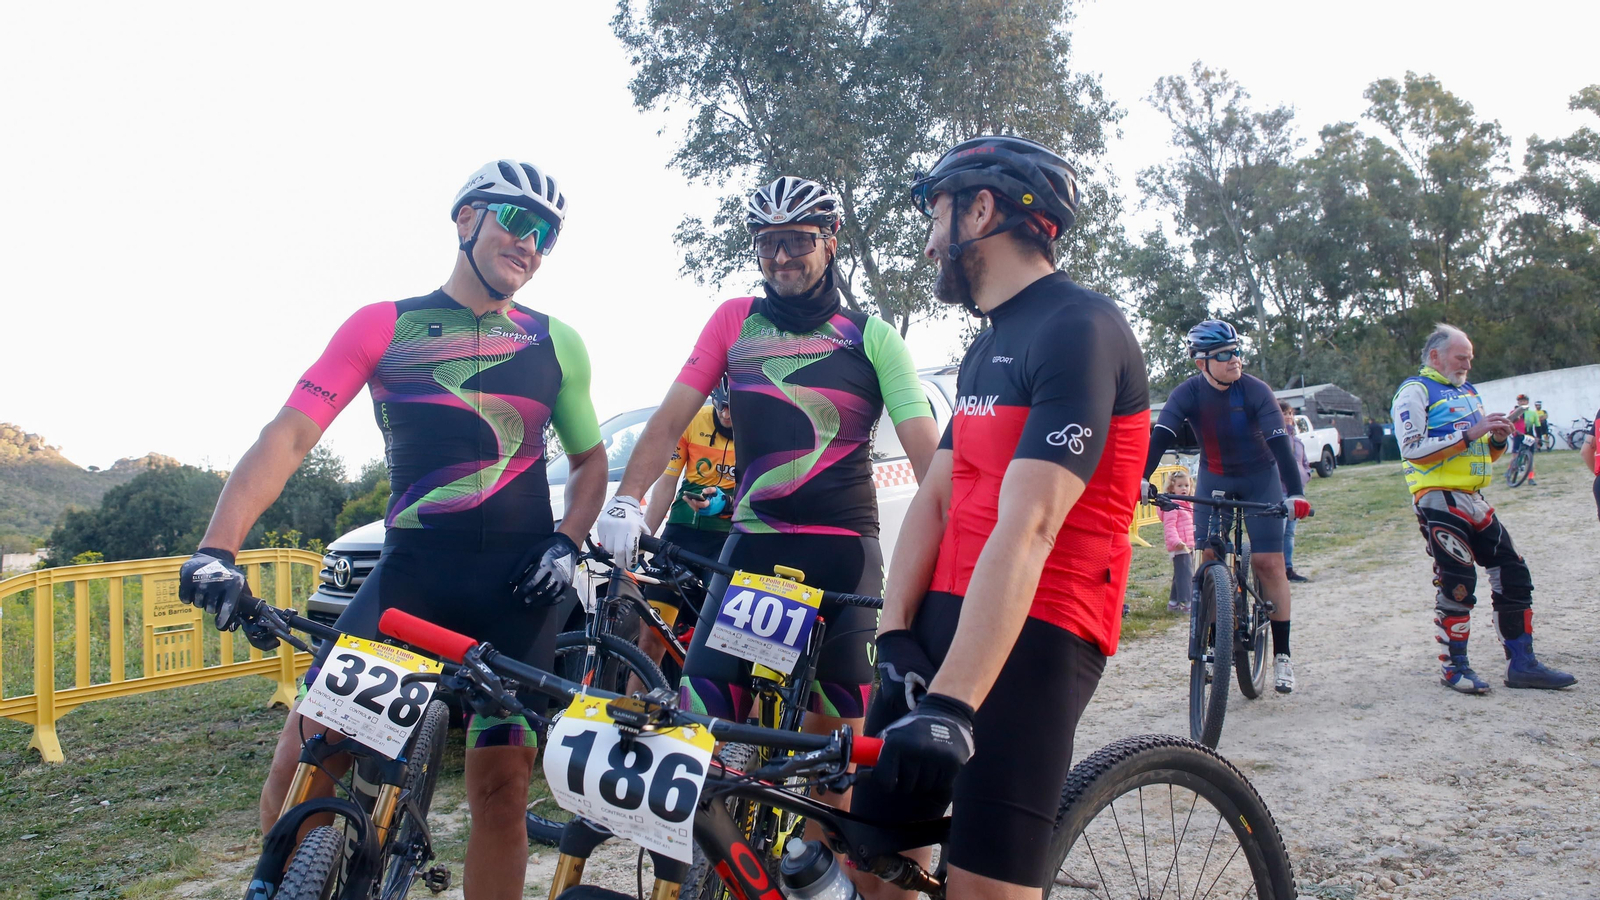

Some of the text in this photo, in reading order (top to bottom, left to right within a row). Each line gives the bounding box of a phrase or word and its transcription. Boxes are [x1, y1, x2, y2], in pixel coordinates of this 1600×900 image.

[487, 326, 538, 342] Surpool
[766, 576, 781, 585] Pollo
[782, 580, 798, 590] Lindo
[168, 607, 193, 616] Barrios
[721, 589, 808, 647] 401
[377, 643, 395, 653] Pollo
[396, 649, 415, 660] Lindo
[312, 688, 332, 701] CONTROL
[324, 652, 431, 729] 328
[348, 706, 368, 718] CONTROL
[612, 709, 638, 722] GARMIN
[324, 714, 345, 728] URGENCIAS
[383, 723, 400, 734] COMIDA
[805, 750, 822, 760] XT
[560, 729, 704, 824] 186
[600, 807, 629, 820] CONTROL
[654, 820, 678, 834] COMIDA
